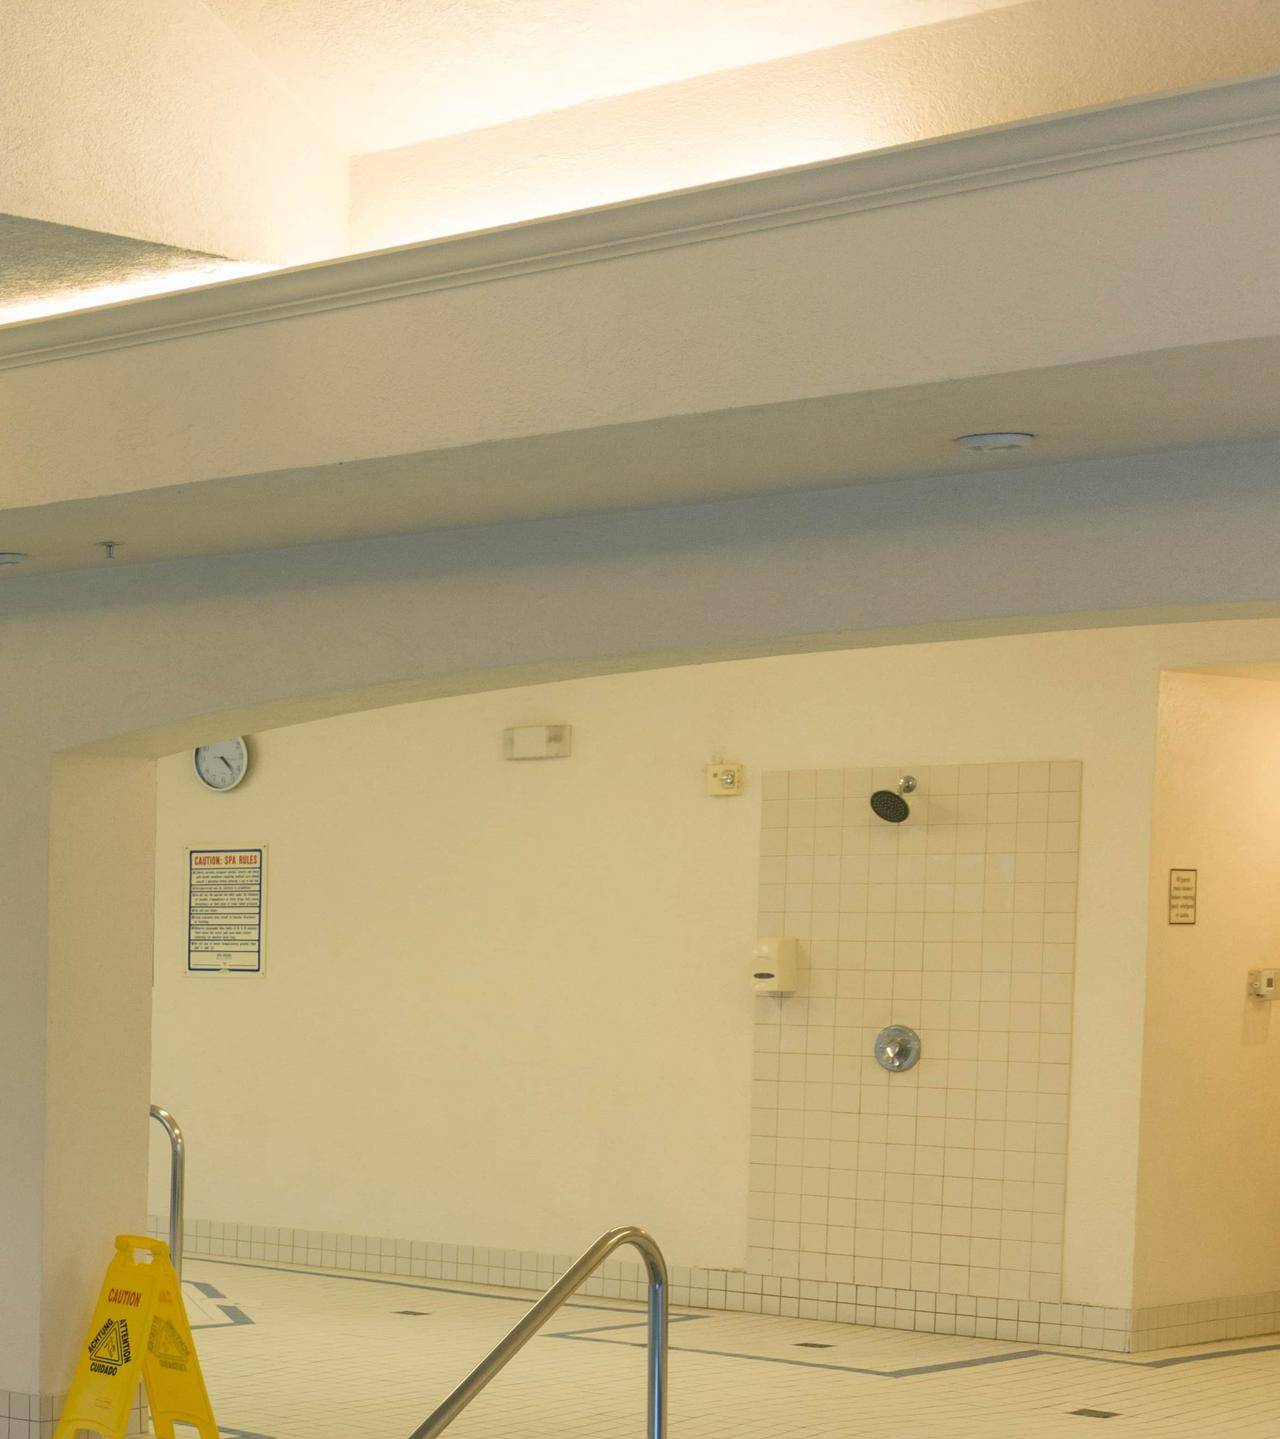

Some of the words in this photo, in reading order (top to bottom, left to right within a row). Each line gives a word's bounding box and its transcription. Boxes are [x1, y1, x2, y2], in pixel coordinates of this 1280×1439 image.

[224, 856, 237, 865] SPA
[239, 855, 258, 865] RULES
[108, 1288, 141, 1307] CAUTION
[88, 1318, 114, 1354] ACHTUNG
[119, 1318, 131, 1364] ATTENTION
[90, 1362, 118, 1376] CUIDADO
